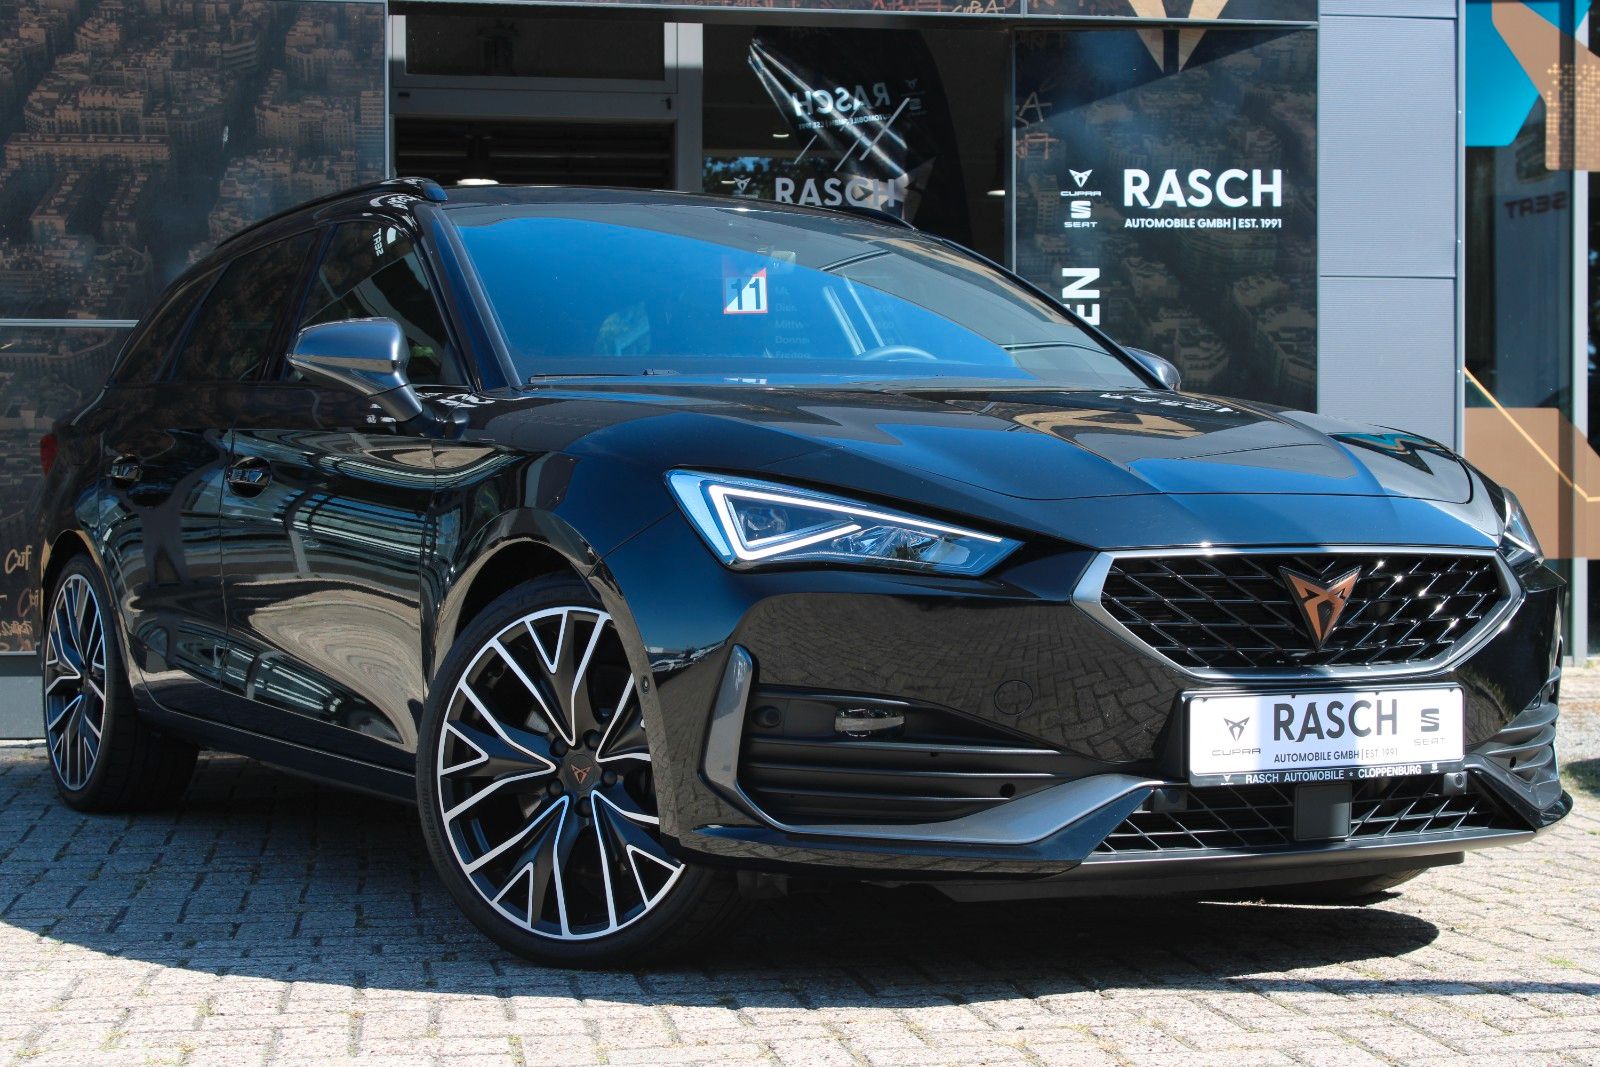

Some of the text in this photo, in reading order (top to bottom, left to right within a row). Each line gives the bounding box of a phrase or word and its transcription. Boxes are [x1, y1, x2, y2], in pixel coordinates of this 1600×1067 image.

[774, 177, 896, 209] RASCH
[1123, 168, 1282, 209] RASCH
[1197, 217, 1231, 229] GMBH
[1260, 218, 1282, 229] 1991
[731, 278, 761, 310] 11
[1273, 698, 1398, 743] RASCH
[1413, 737, 1447, 746] SEAT
[1211, 747, 1262, 757] CUPRA
[1273, 751, 1332, 764] AUTOMOBILE
[1333, 750, 1360, 760] GMBH
[1245, 774, 1279, 785] RASCH
[1284, 770, 1345, 782] AUTOMOBILE
[1358, 765, 1422, 779] CLOPPENBURG
